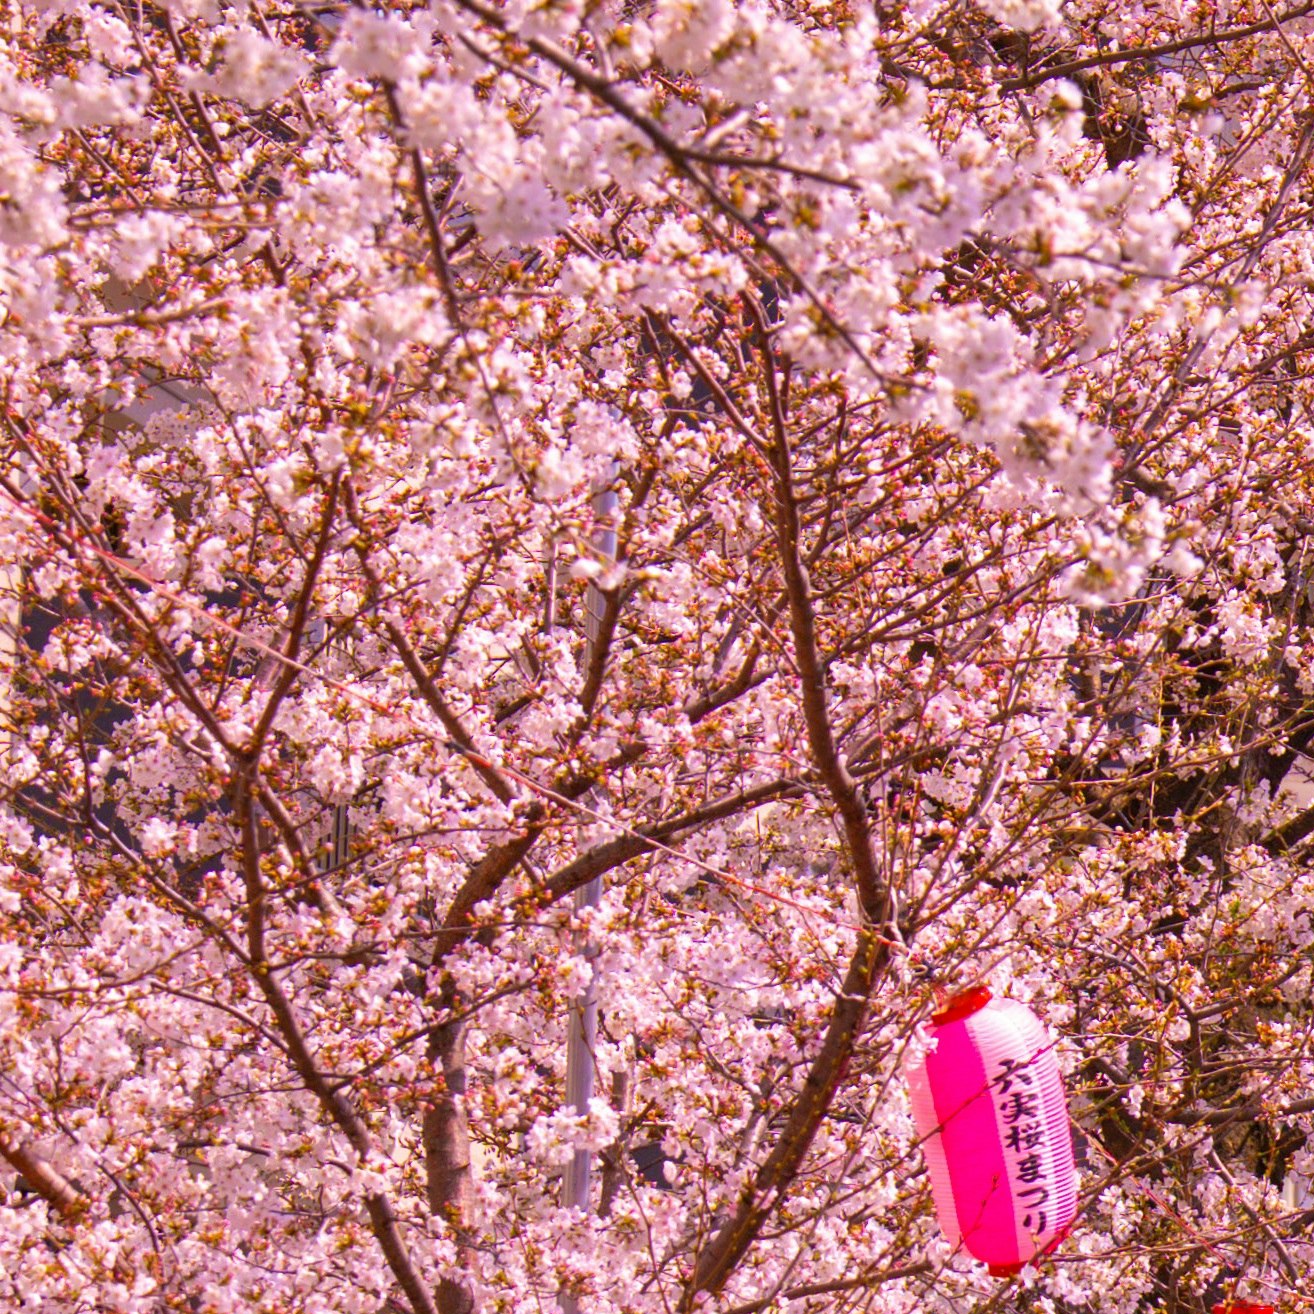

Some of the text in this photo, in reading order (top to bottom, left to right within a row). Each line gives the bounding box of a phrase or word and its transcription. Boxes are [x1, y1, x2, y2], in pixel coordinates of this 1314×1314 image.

[992, 1058, 1049, 1236] 六実桜まつり
